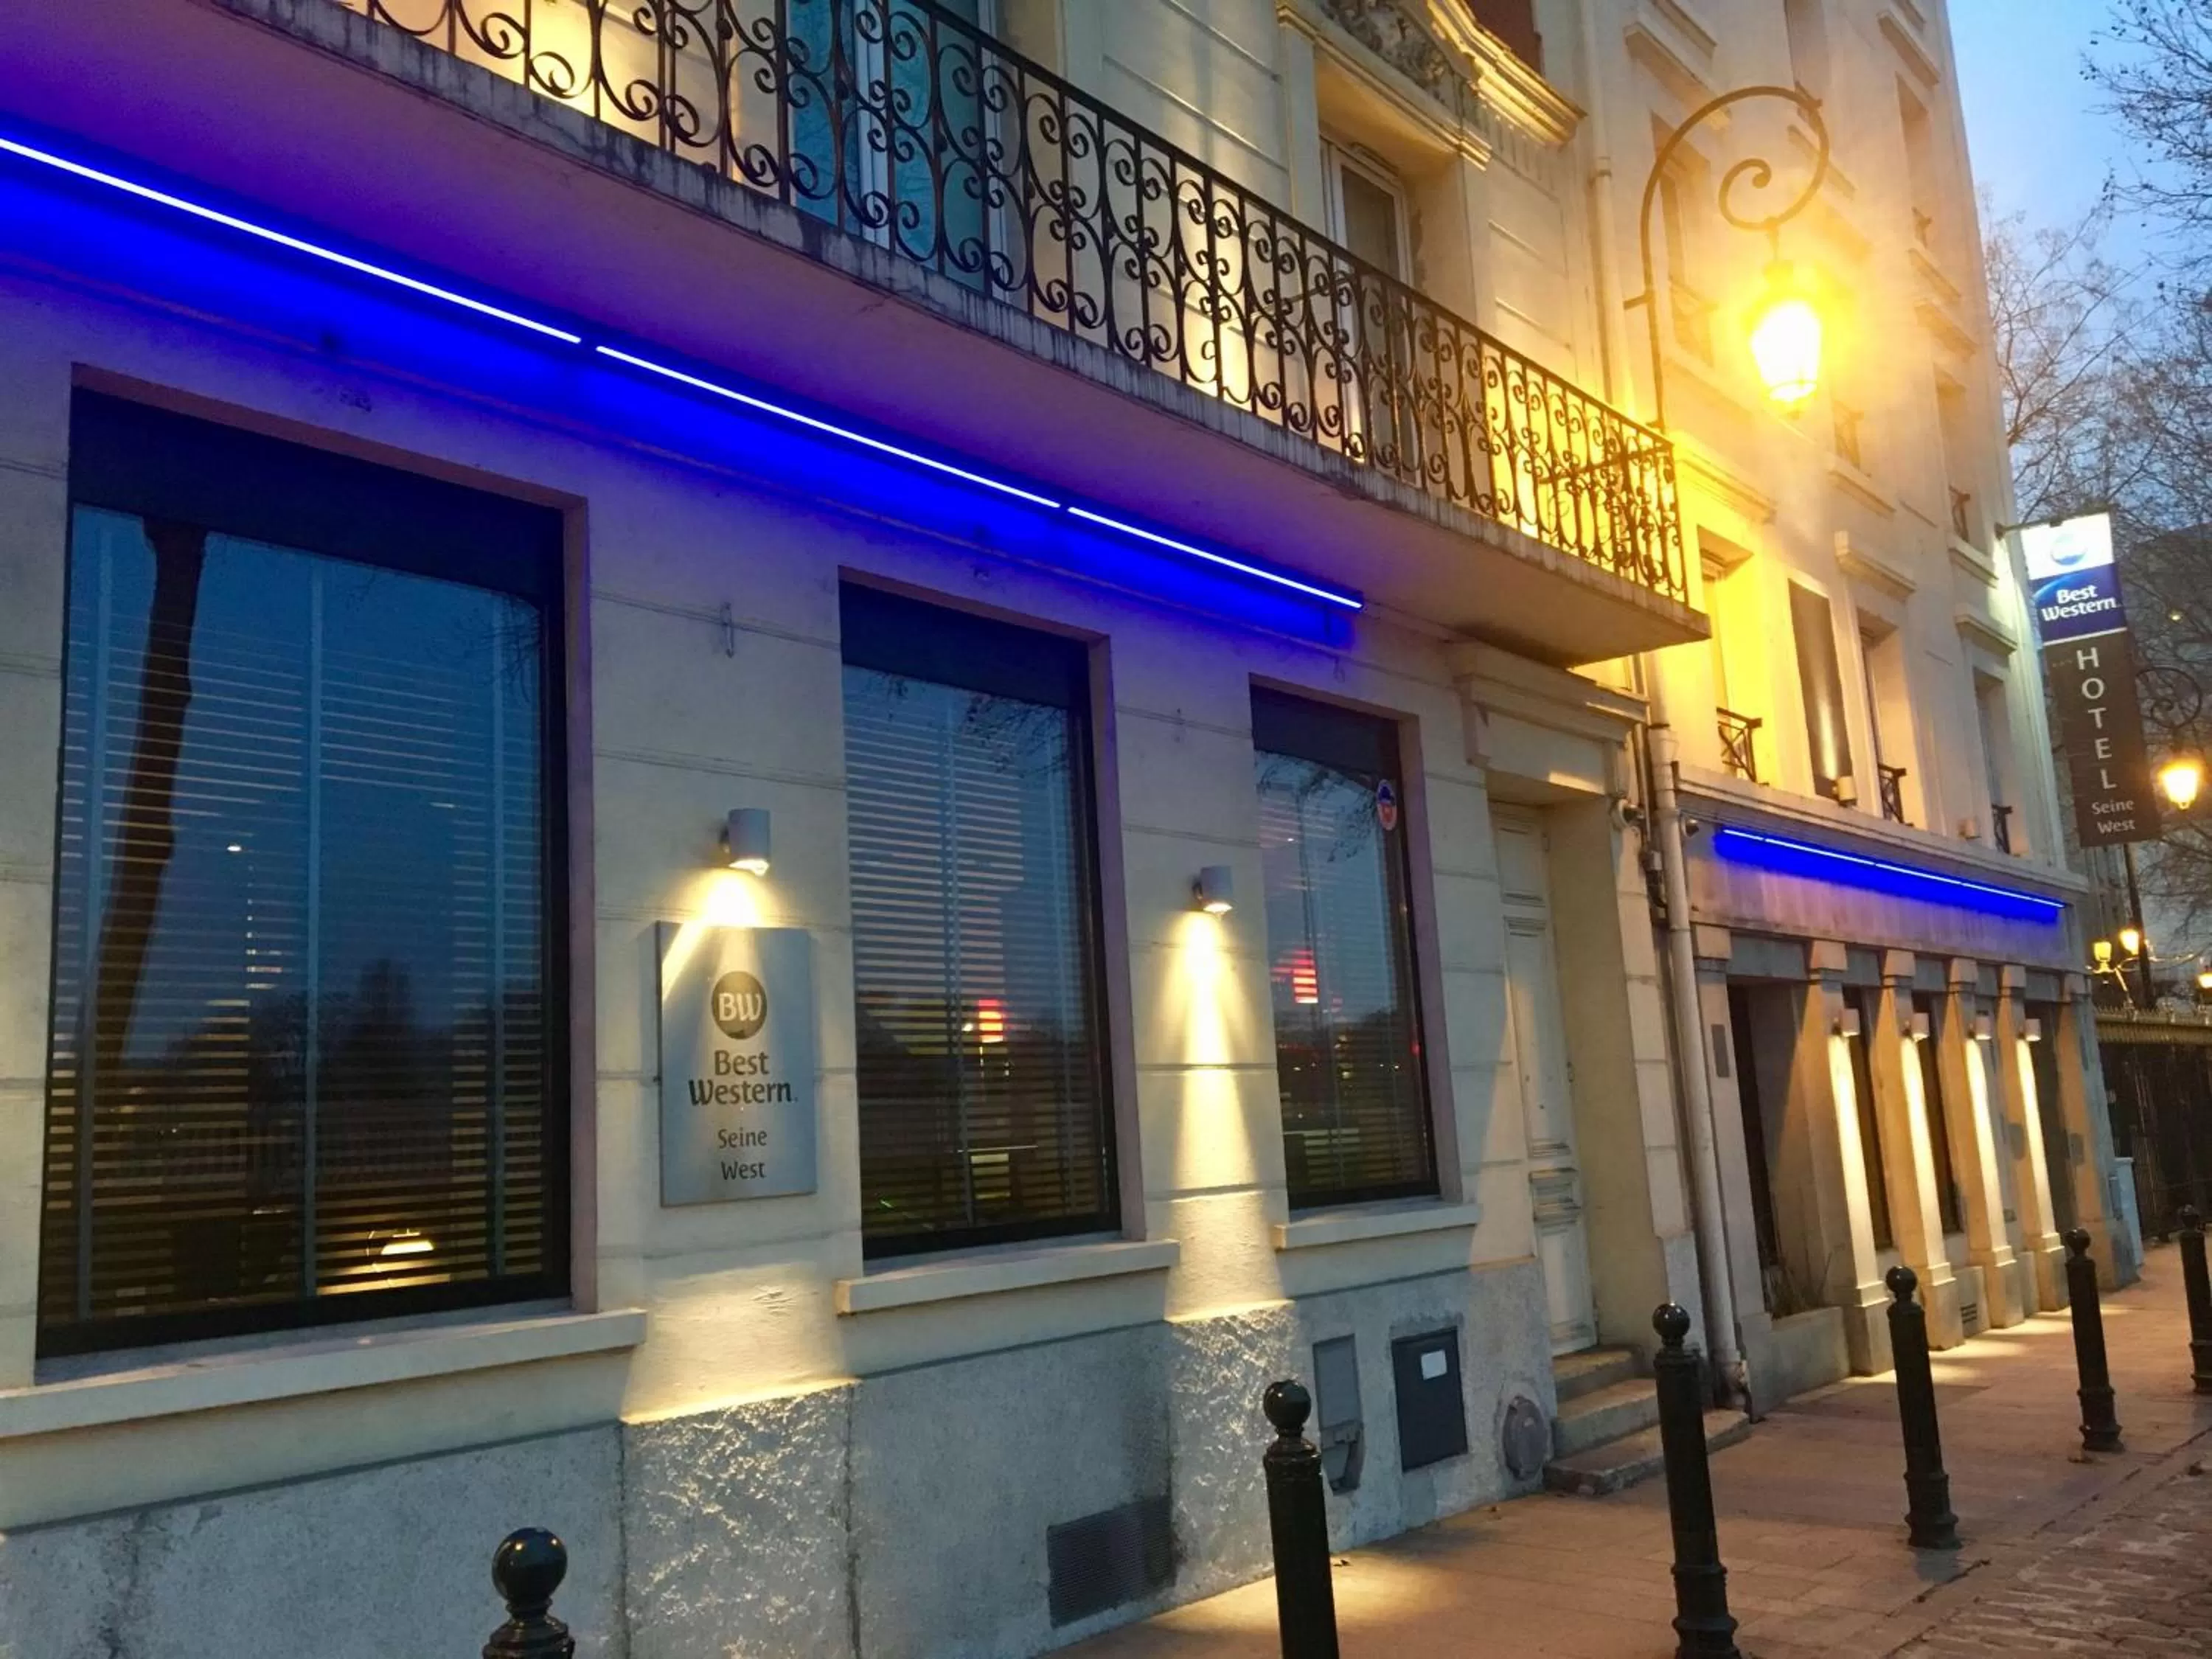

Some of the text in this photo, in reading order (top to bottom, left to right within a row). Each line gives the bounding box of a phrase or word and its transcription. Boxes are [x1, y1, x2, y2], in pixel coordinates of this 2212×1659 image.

[2056, 585, 2098, 604] Best
[2076, 647, 2118, 790] HOTEL
[2091, 799, 2135, 815] Seine
[2097, 819, 2136, 835] West
[718, 992, 762, 1022] BW
[714, 1050, 769, 1076] Best
[717, 1128, 768, 1150] Seine
[720, 1161, 767, 1180] West
